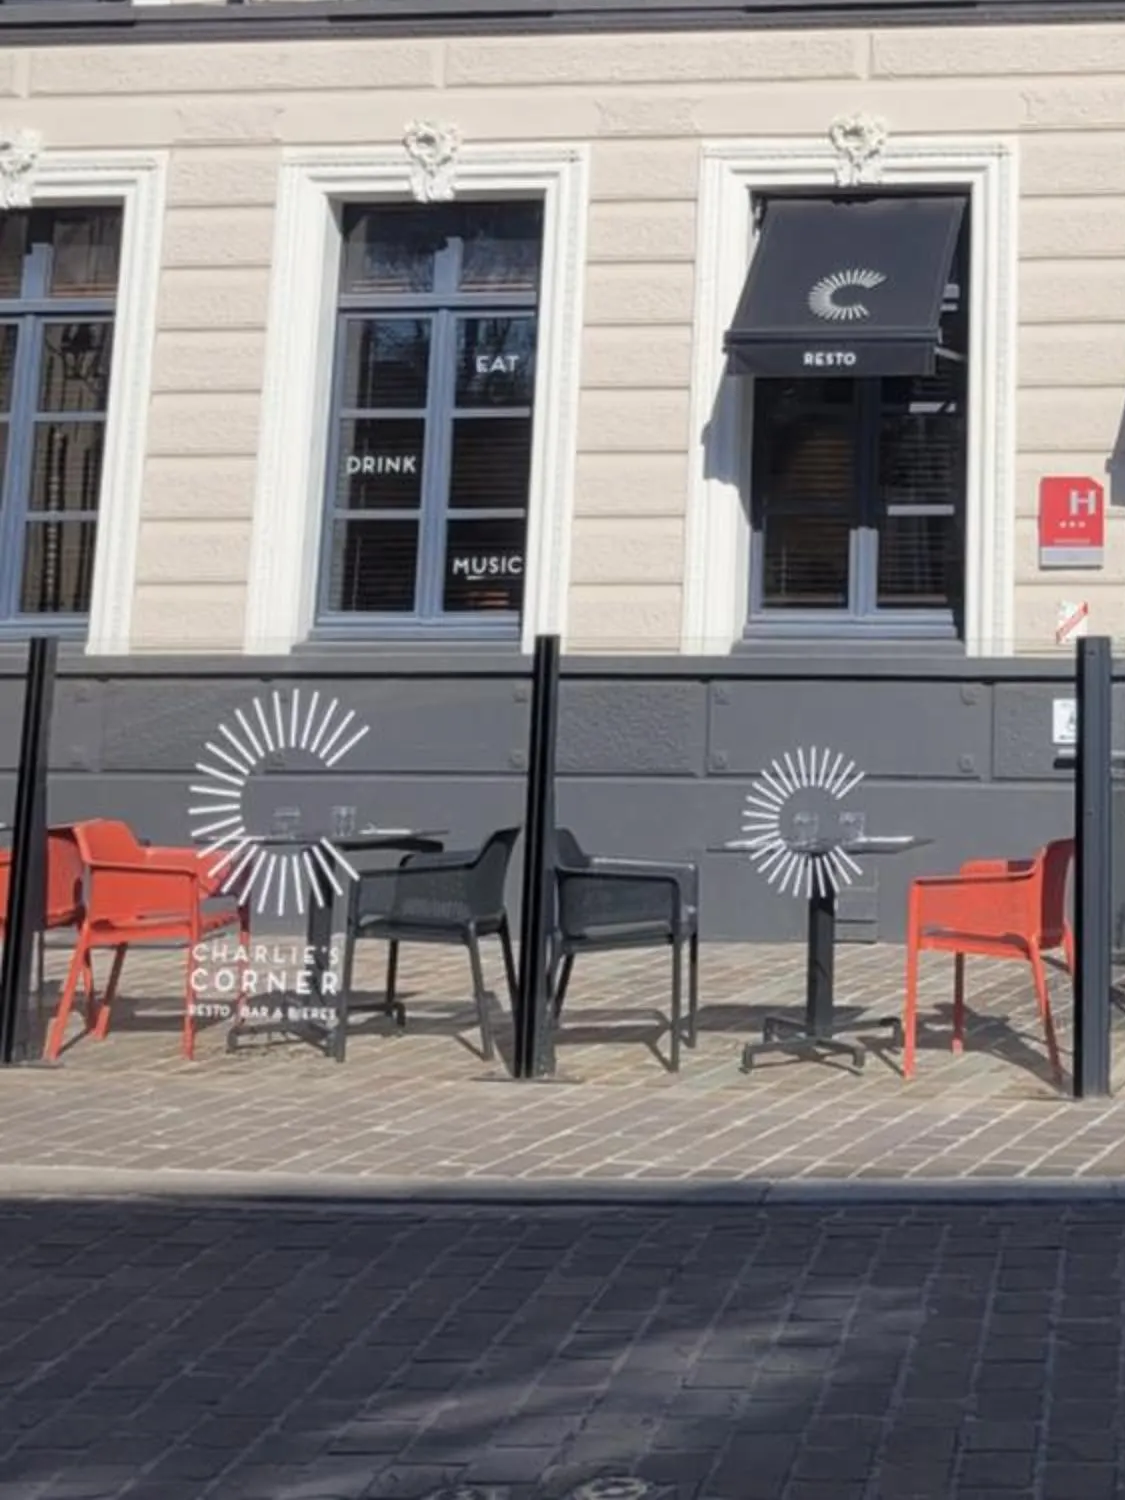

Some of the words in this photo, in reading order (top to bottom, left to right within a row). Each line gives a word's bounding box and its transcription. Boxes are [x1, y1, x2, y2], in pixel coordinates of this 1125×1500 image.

[476, 355, 520, 373] EAT
[803, 352, 857, 367] RESTO
[346, 456, 417, 474] DRINK
[1069, 489, 1097, 516] H
[453, 556, 523, 574] MUSIC
[192, 943, 339, 965] CHARLIE'S
[190, 968, 338, 995] CORNER
